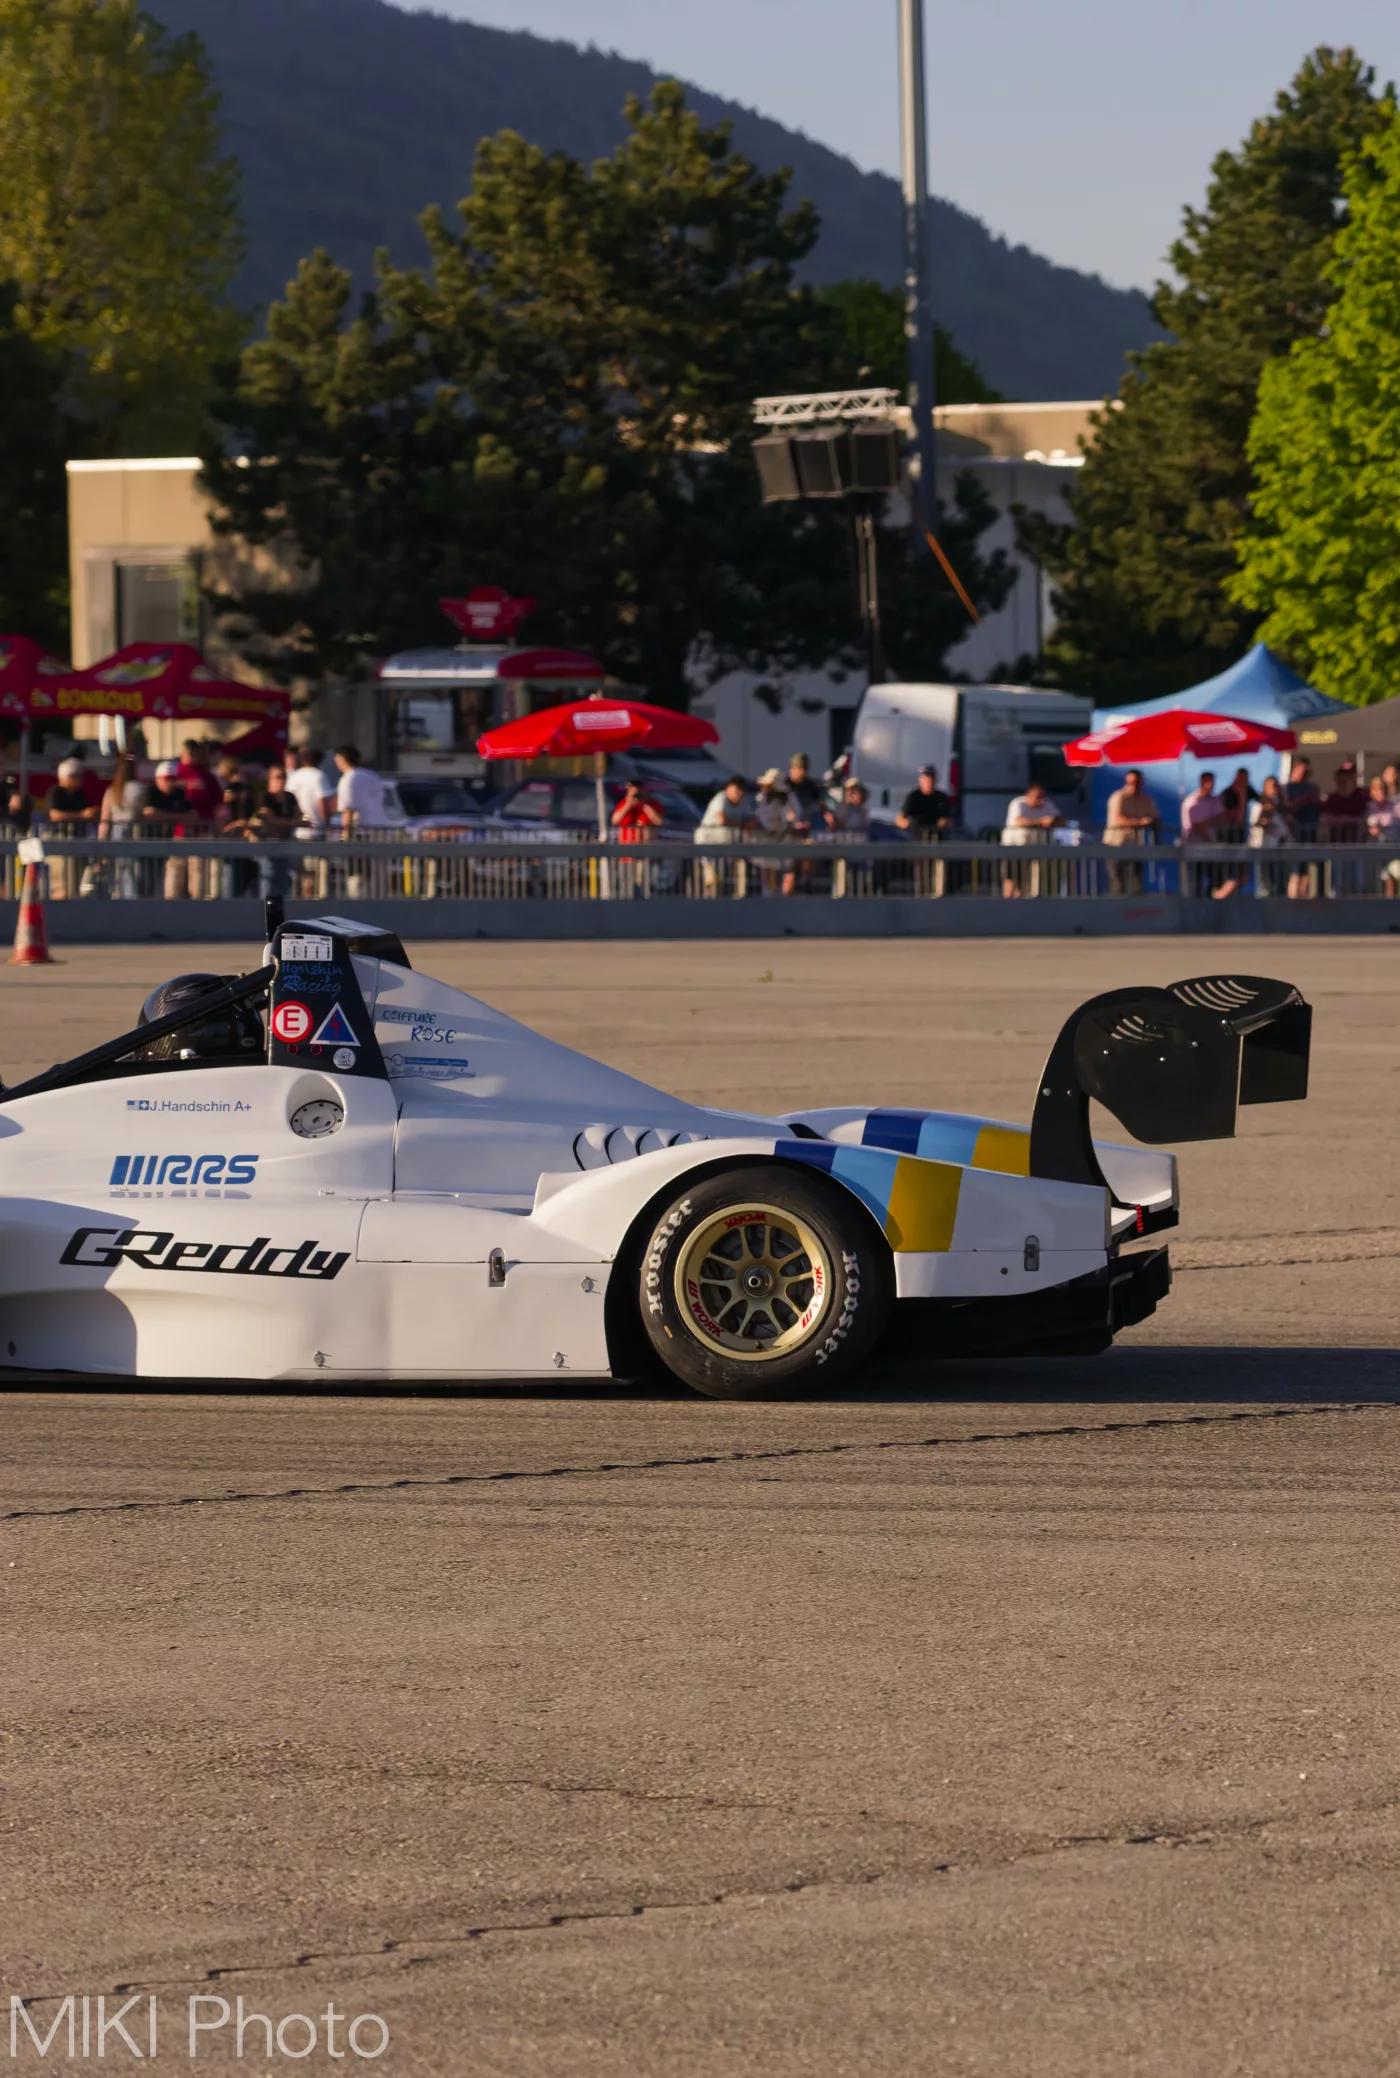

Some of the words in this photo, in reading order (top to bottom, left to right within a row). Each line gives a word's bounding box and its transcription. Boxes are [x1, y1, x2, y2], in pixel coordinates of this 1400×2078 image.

[283, 1009, 300, 1031] E
[382, 1009, 437, 1024] COIFFURE
[410, 1024, 457, 1044] ROSE
[149, 1100, 231, 1112] J.Handschin
[234, 1101, 252, 1111] A+
[724, 1212, 767, 1229] WORK
[59, 1227, 351, 1280] GReddy
[691, 1301, 724, 1337] WORK
